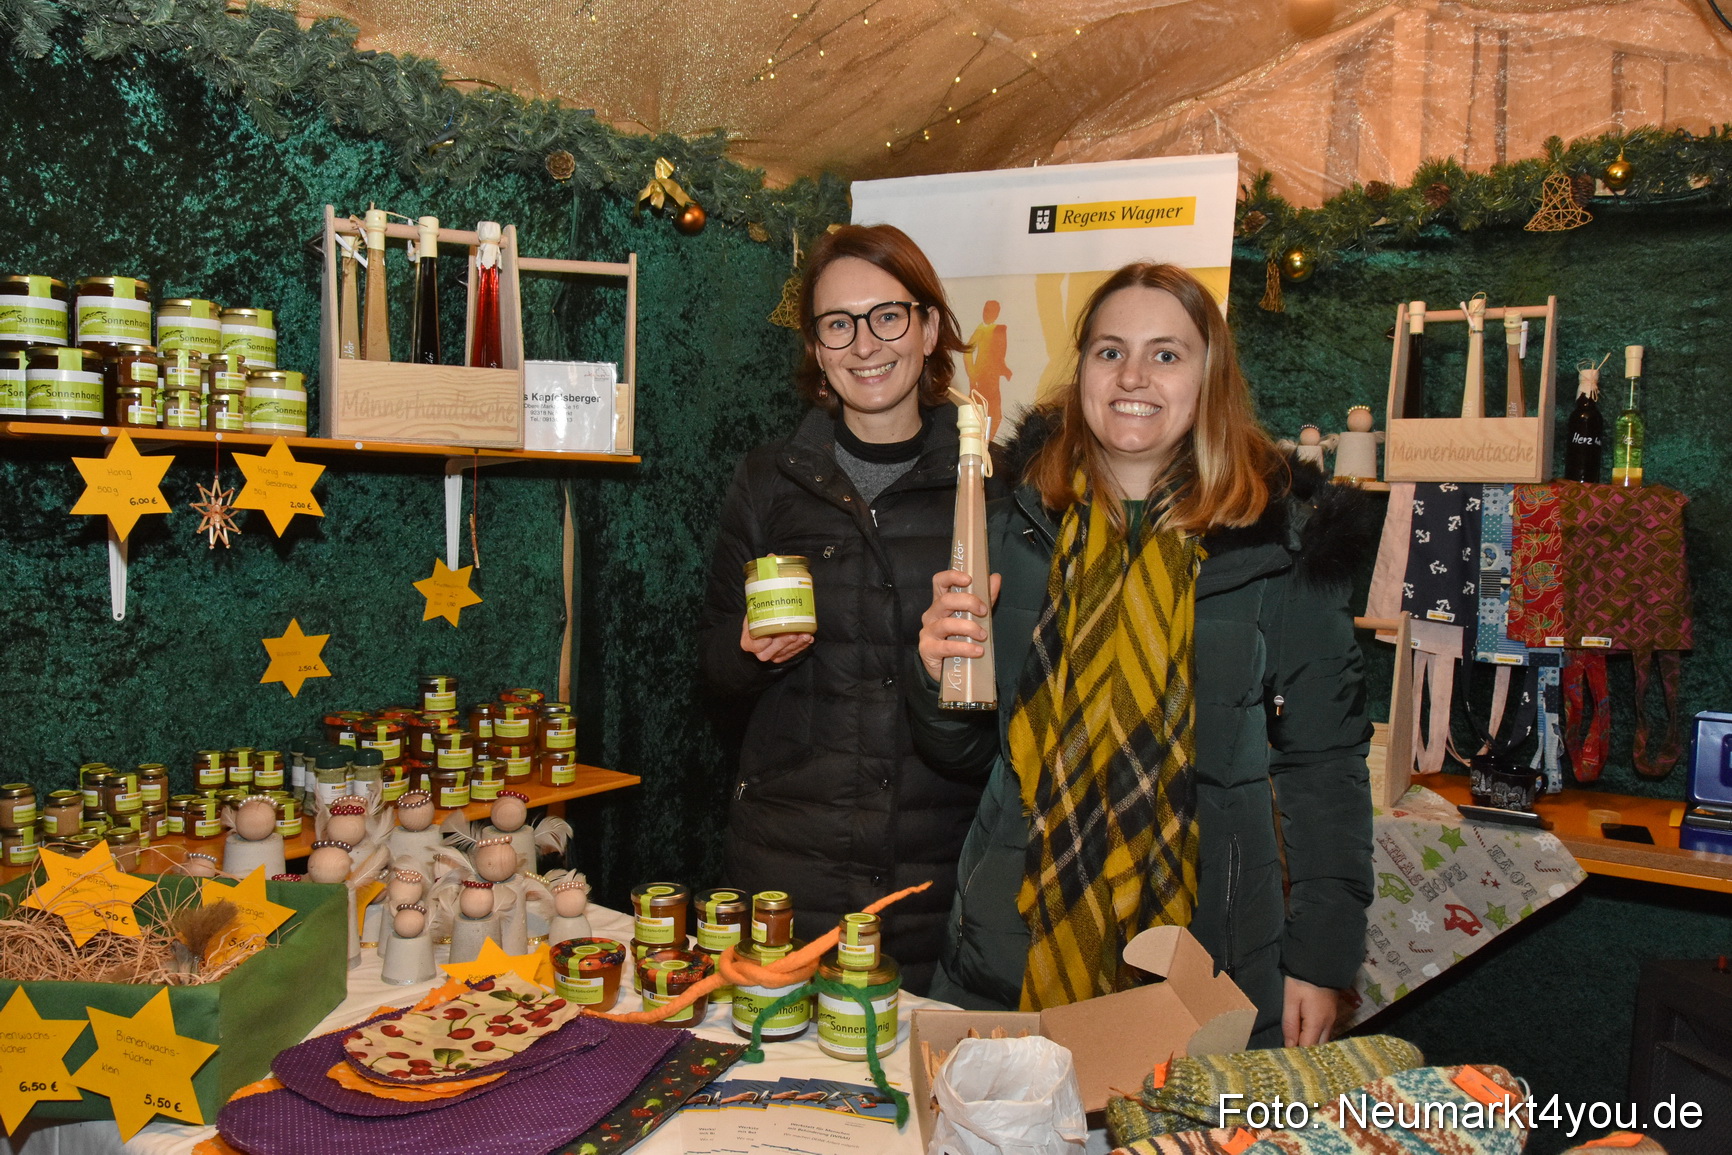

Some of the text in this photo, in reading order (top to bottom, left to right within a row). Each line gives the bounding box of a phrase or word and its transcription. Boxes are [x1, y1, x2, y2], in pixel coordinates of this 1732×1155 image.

[1062, 206, 1183, 227] Regens Wagner
[101, 315, 150, 330] Sonnenhonig
[46, 389, 100, 402] Sonnenhonig
[341, 390, 515, 424] Männerhandtasche
[1572, 432, 1593, 445] Herz
[1391, 439, 1535, 463] Männerhandtasche
[106, 468, 133, 480] Honig
[952, 539, 965, 572] Likör
[752, 596, 803, 610] Sonnenhonig
[1376, 832, 1425, 887] XMAS
[1486, 844, 1538, 900] LOVE
[1418, 862, 1468, 903] HOPE
[1366, 923, 1412, 979] LOVE
[748, 1003, 804, 1014] Sonhonig
[830, 1020, 890, 1033] Sonnennig
[123, 1049, 154, 1066] tücher
[51, 1081, 58, 1092] €
[174, 1102, 182, 1112] €
